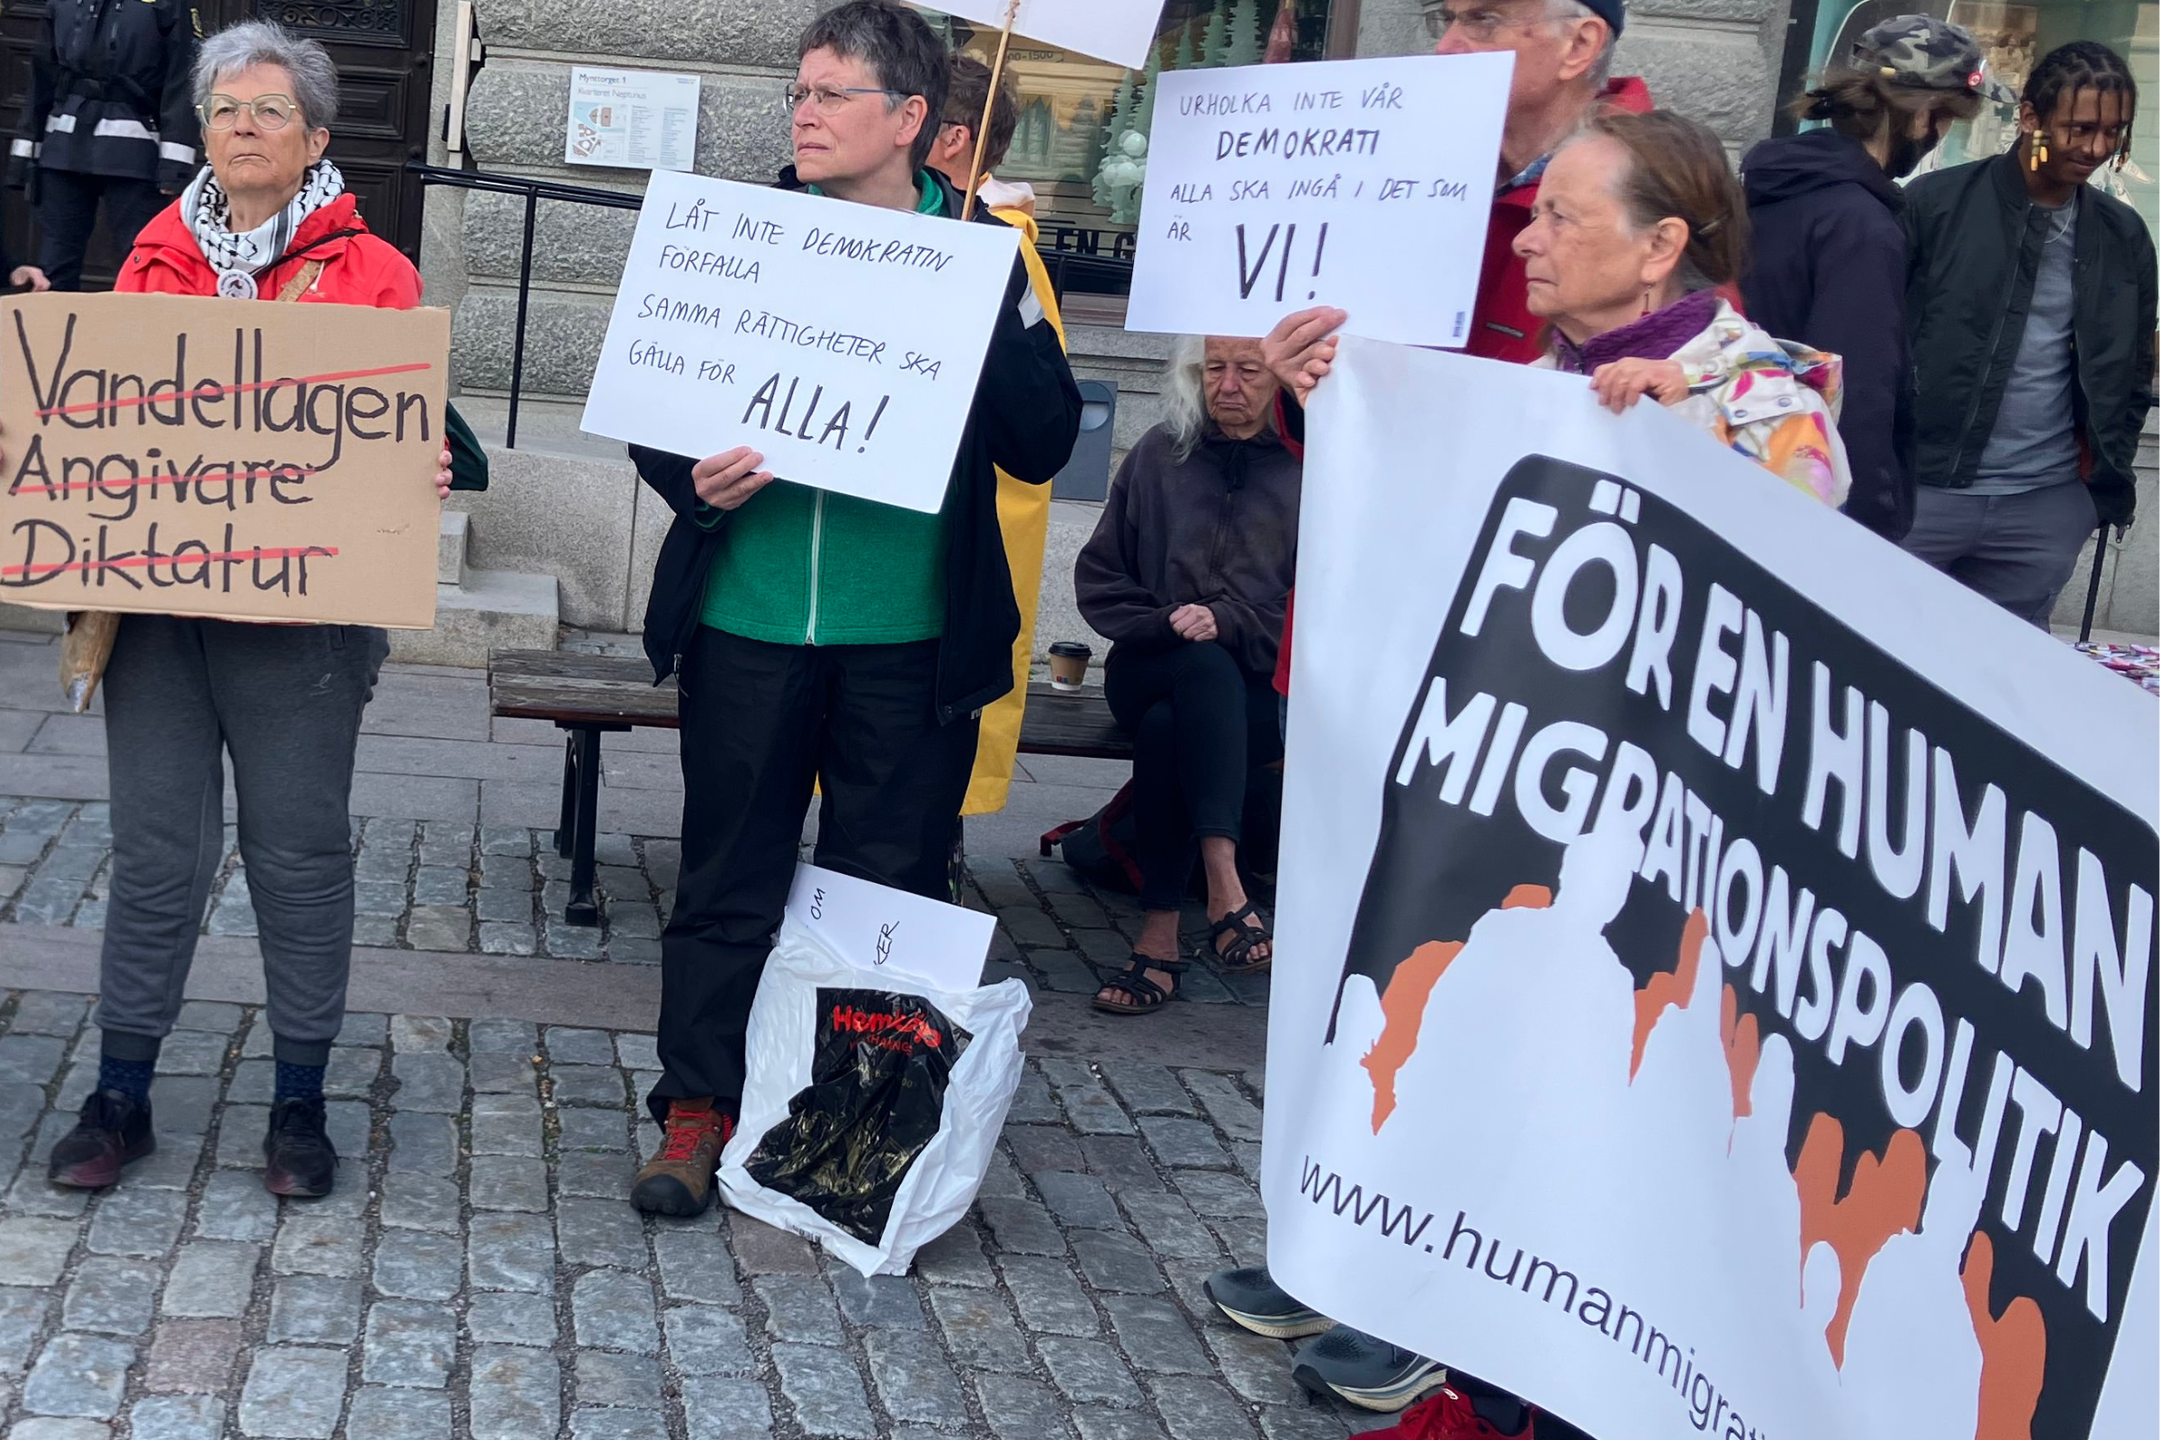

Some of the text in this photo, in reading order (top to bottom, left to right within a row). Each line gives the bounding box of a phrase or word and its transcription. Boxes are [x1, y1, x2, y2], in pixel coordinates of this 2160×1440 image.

[579, 73, 620, 85] Mynttorget
[1180, 82, 1403, 117] URHOLKA INTE VÅR
[1170, 173, 1468, 203] ALLA SKA INGÅ I DET SOM
[1216, 127, 1380, 161] DEMOKRATI
[659, 245, 761, 284] FÖRFALLA
[665, 198, 954, 273] LÅT INTE DEMOKRATIN
[1167, 214, 1329, 303] ÄR VI!
[638, 293, 942, 382] SAMMA RÄTTIGHETER SKA
[13, 308, 430, 472] Vandellagen
[629, 339, 890, 454] GÄLLA FÖR ALLA!
[8, 433, 314, 521] Angivare
[0, 519, 335, 598] Diktatur
[1459, 478, 2154, 1094] FÖR EN HUMAN
[1395, 675, 2147, 1325] MIGRATIONSPOLITIK
[1300, 1154, 1766, 1440] www.humanmigra
